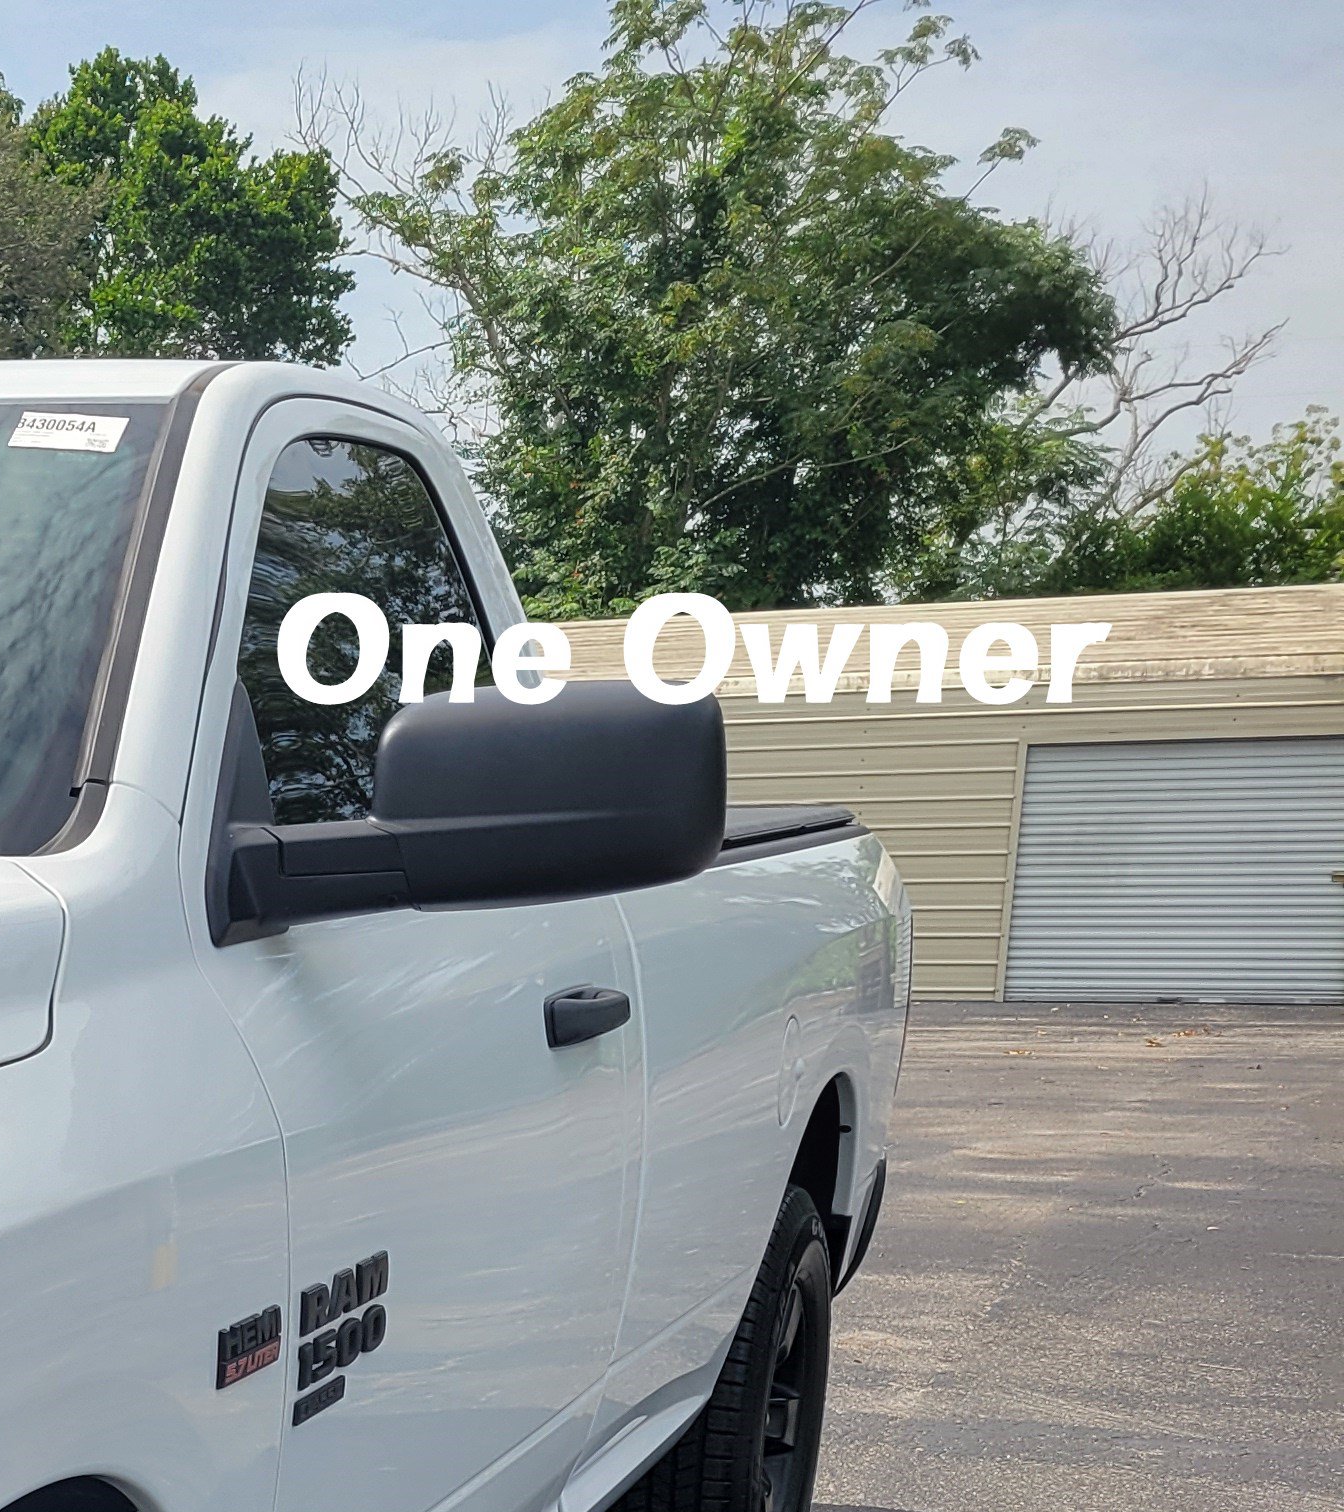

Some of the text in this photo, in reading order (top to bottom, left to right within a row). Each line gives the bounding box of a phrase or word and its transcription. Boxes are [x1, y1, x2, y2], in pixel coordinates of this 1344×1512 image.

[217, 1304, 282, 1360] HEMI
[299, 1250, 389, 1337] RAM
[297, 1303, 387, 1391] 1500
